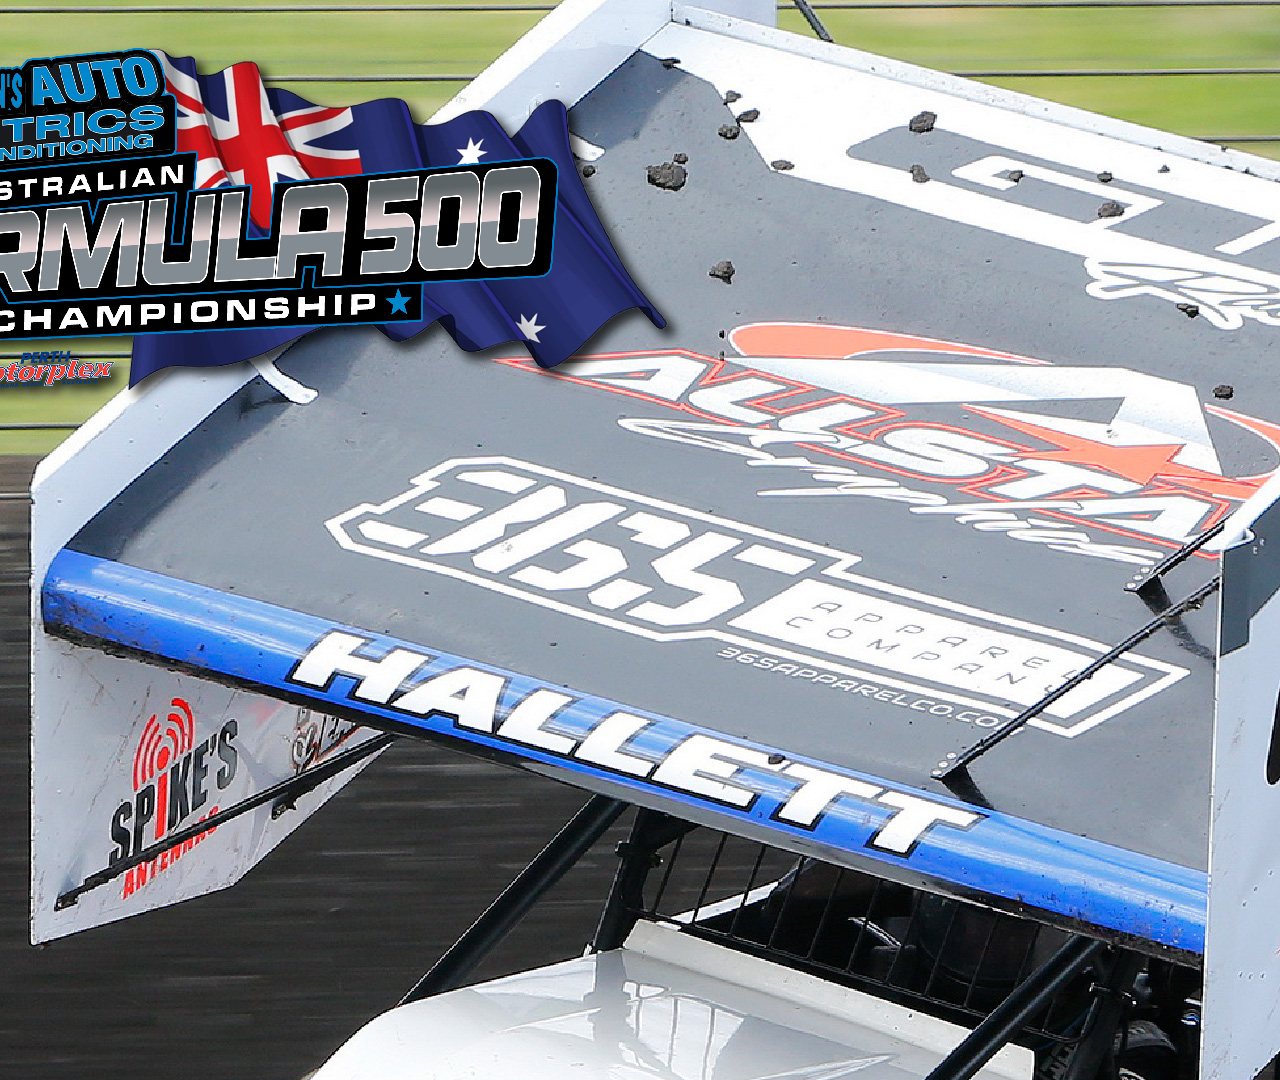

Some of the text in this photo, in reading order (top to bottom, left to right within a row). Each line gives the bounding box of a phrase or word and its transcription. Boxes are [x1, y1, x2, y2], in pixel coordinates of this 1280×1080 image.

[556, 354, 1210, 547] ALLSTA
[357, 468, 818, 628] 365
[289, 627, 988, 859] HALLETT
